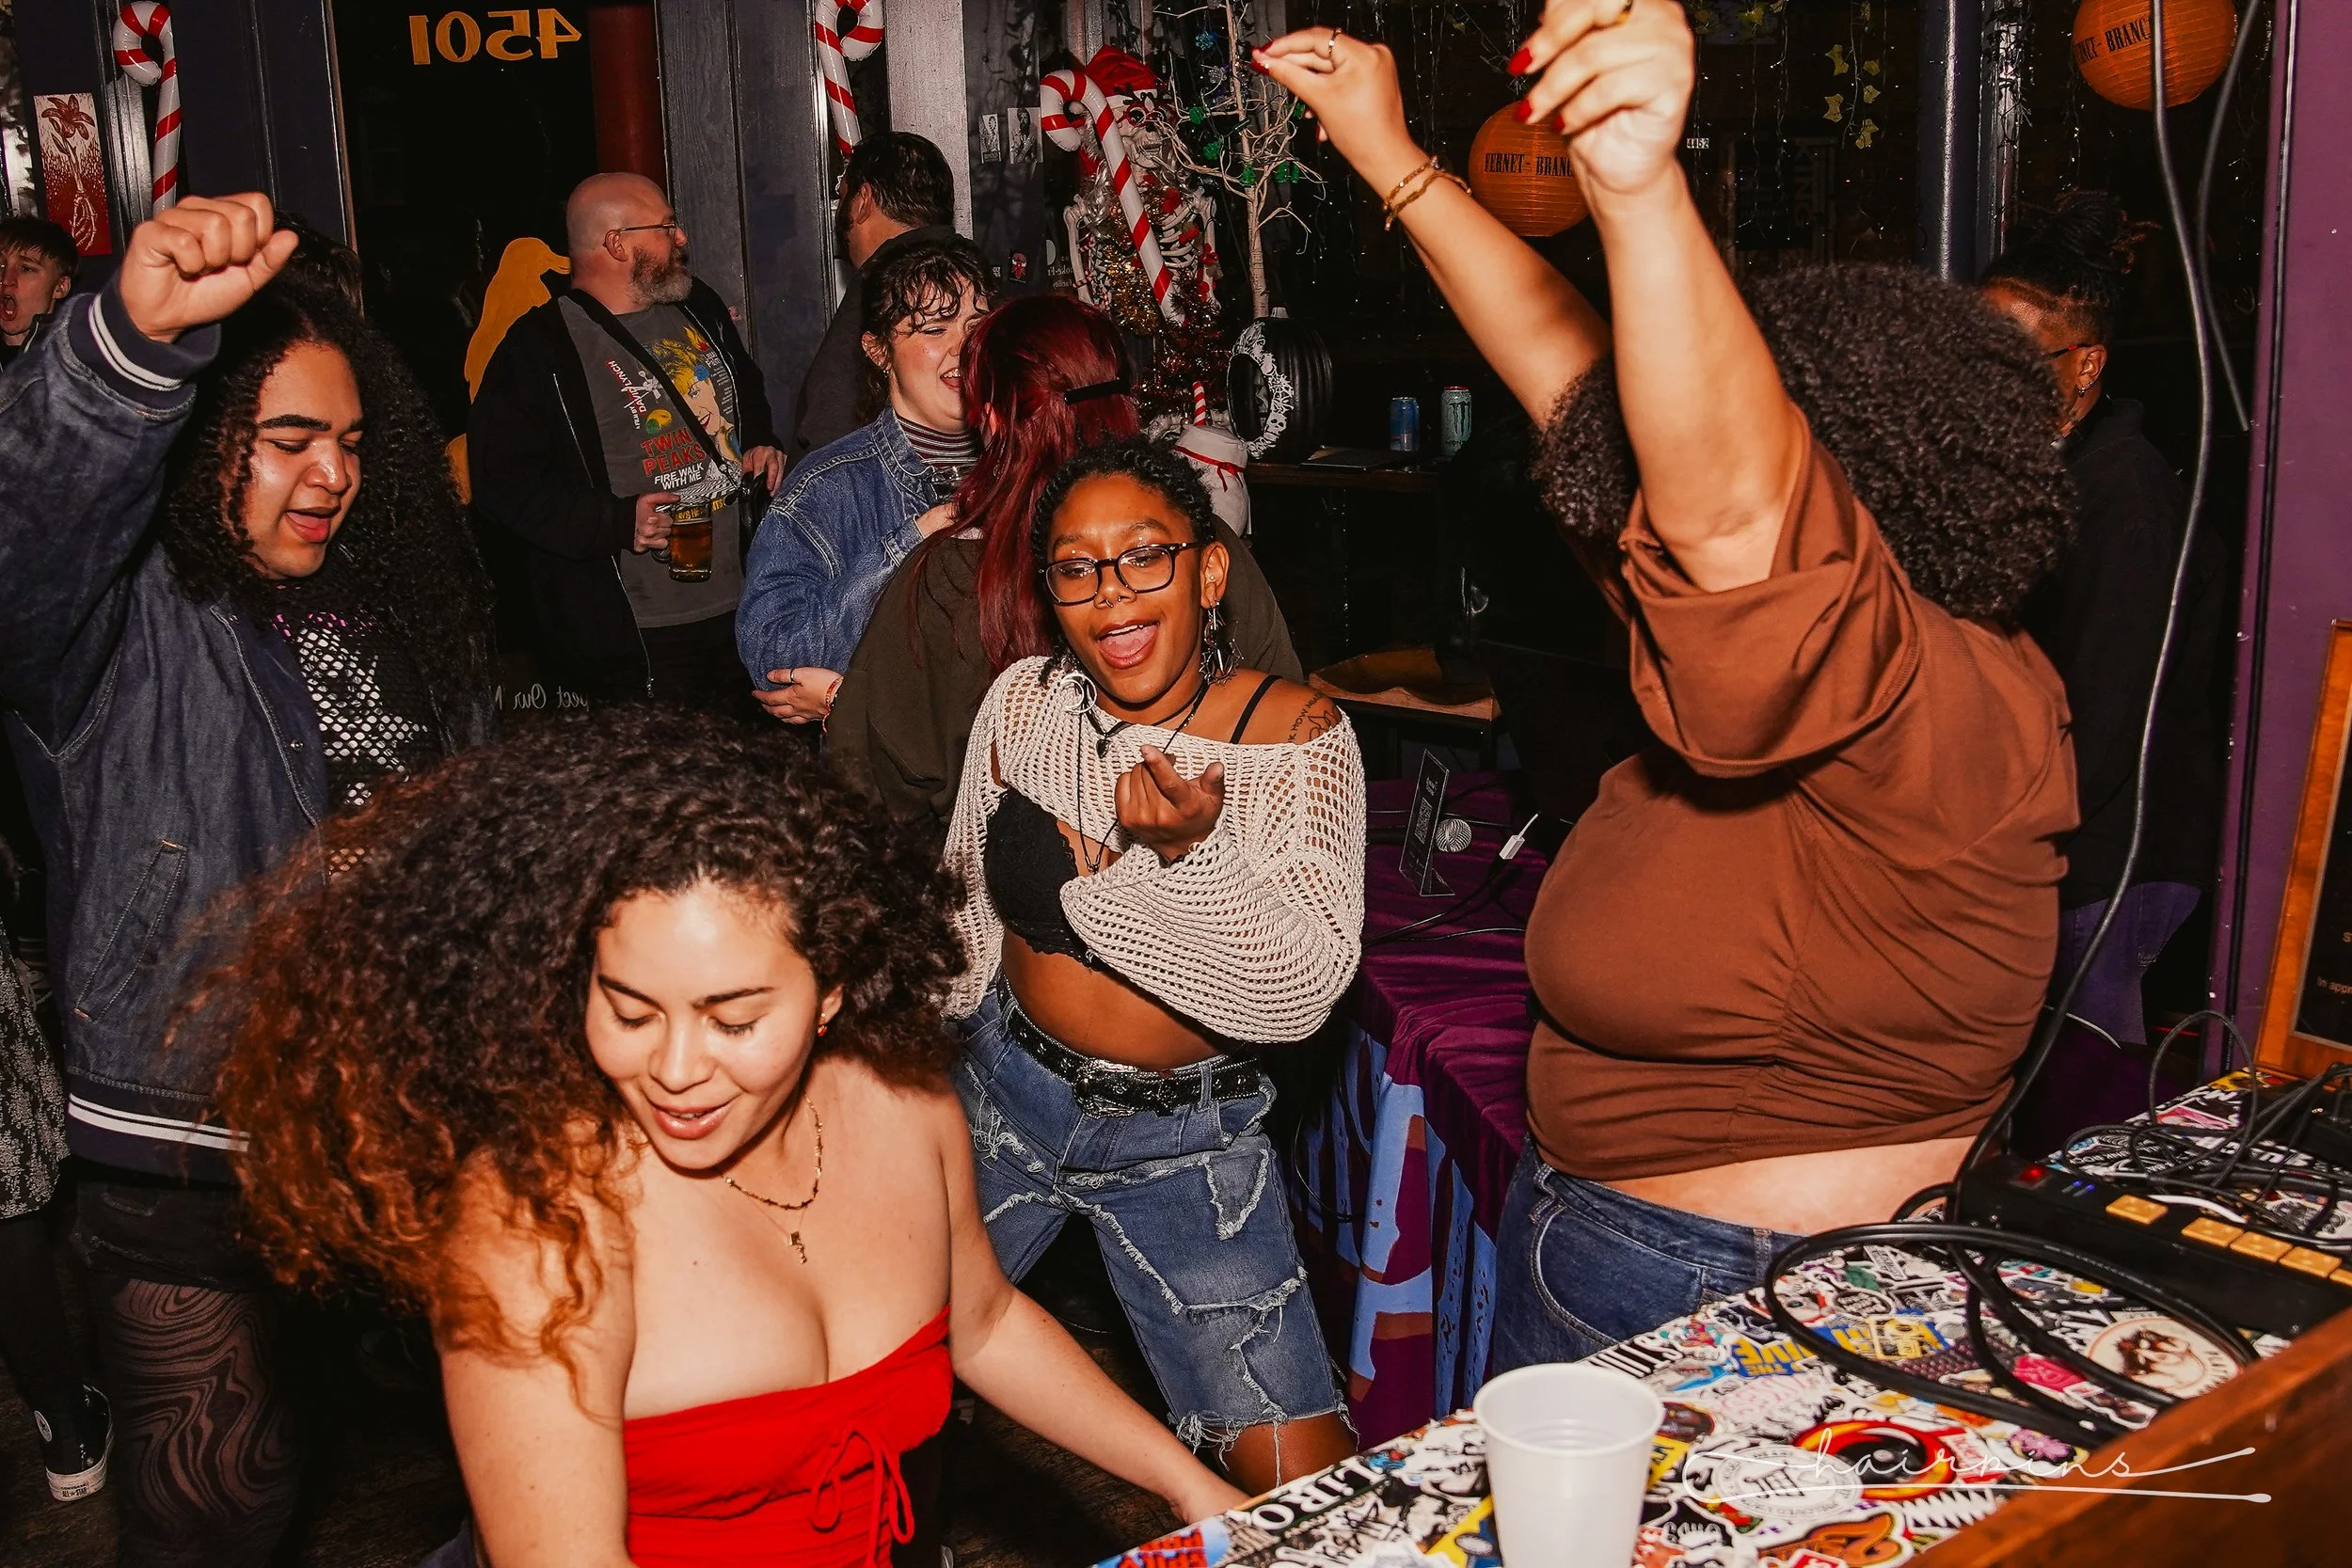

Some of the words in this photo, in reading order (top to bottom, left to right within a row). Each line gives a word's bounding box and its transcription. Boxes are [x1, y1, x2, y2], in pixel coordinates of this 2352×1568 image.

[2104, 16, 2151, 53] BRANC
[1484, 152, 1525, 174] FERNET
[1534, 155, 1575, 178] BRANC
[608, 360, 632, 387] LYNCH
[641, 427, 693, 457] TWIN
[643, 442, 707, 477] PEAKS
[654, 471, 677, 484] FIRE
[678, 462, 704, 478] WALK
[661, 477, 688, 490] WITH
[689, 470, 703, 483] ME
[1290, 708, 1309, 731] HOW
